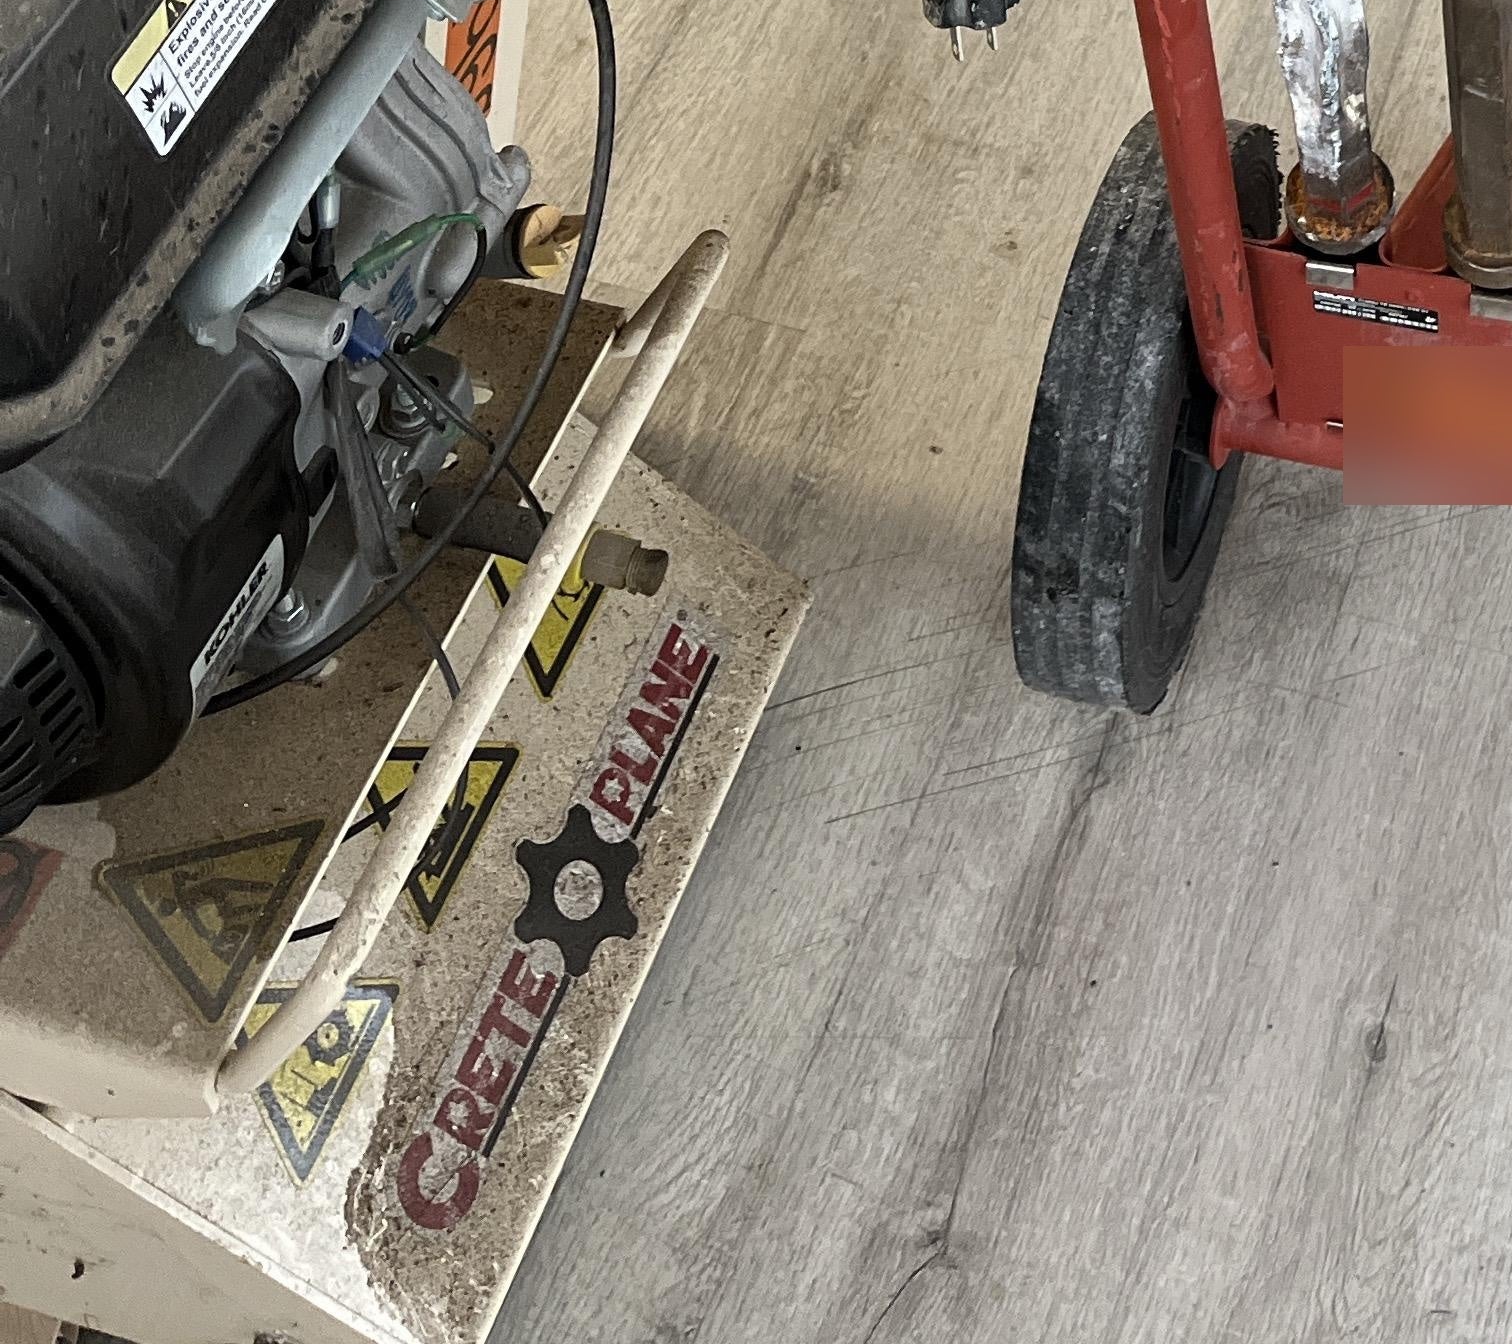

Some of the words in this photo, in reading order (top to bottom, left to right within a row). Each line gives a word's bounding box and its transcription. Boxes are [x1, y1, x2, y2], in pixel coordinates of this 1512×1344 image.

[176, 33, 201, 67] fires
[200, 9, 219, 34] and
[400, 949, 558, 1230] CRETE
[591, 623, 707, 824] PLANE
